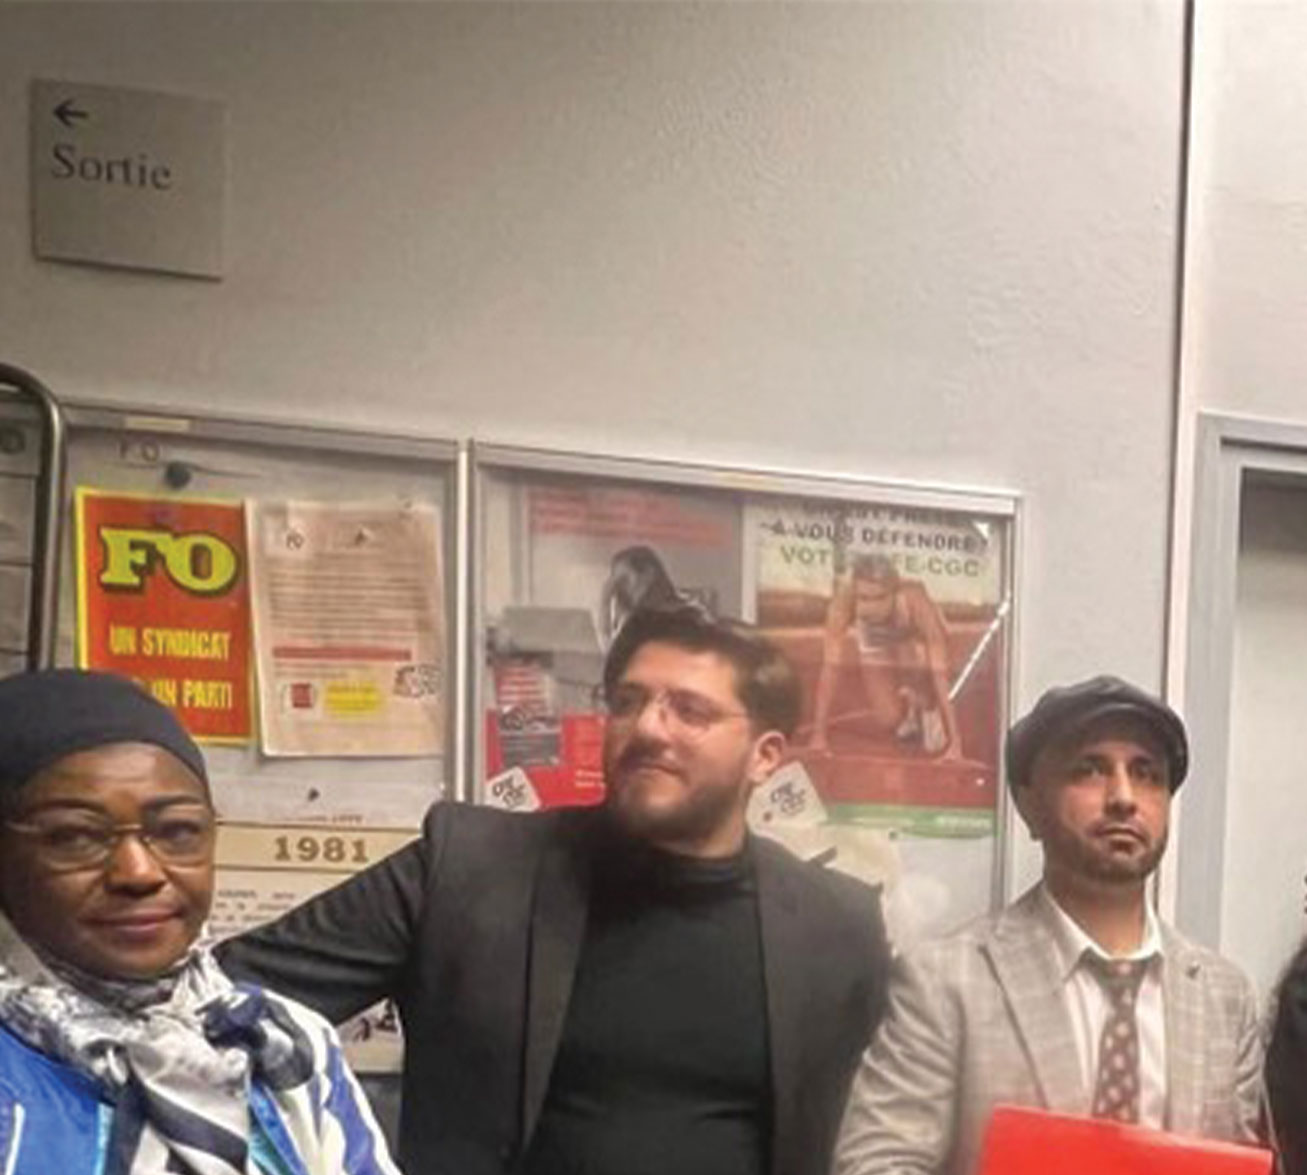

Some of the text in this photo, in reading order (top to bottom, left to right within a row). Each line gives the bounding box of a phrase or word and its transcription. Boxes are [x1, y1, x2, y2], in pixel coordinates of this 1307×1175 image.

[51, 143, 171, 190] Sortie
[99, 526, 239, 596] FO
[109, 623, 232, 662] UN SYNDICAT
[183, 678, 233, 709] PARTI
[273, 835, 370, 864] 1981
